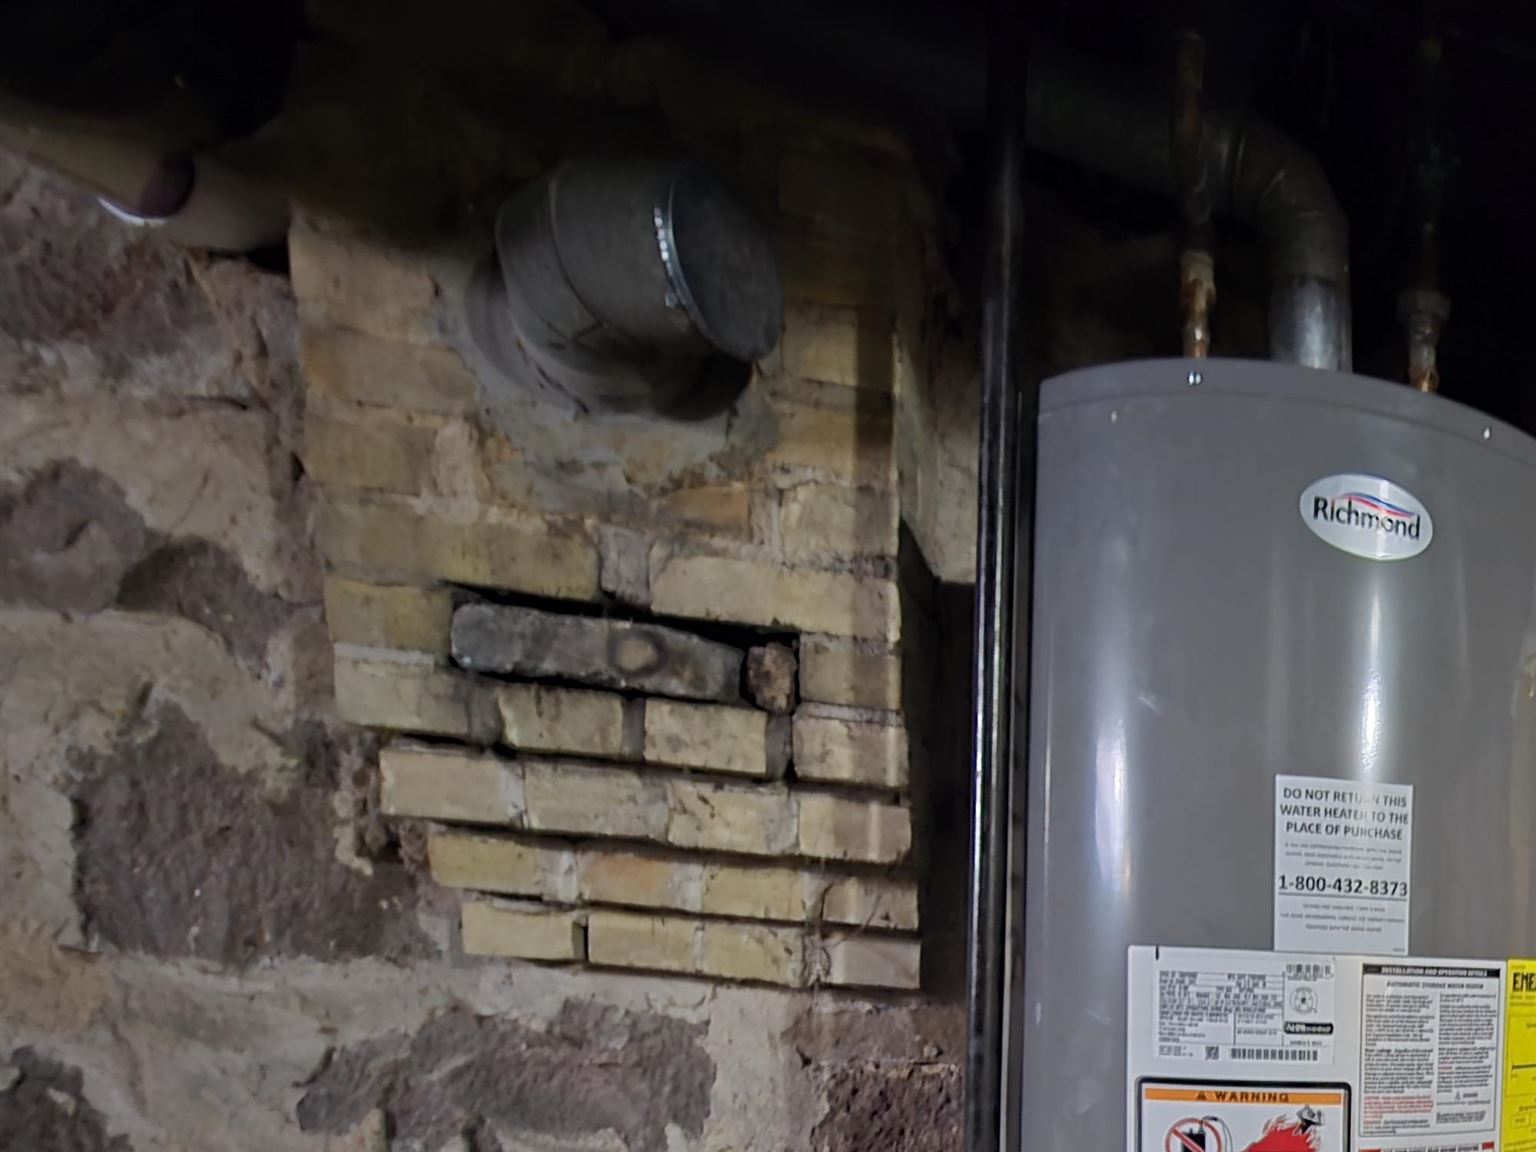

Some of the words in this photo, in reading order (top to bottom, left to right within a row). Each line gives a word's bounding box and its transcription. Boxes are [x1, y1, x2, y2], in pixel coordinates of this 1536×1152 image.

[1313, 496, 1421, 540] Richmond
[1283, 787, 1302, 799] DO
[1305, 789, 1331, 802] NOT
[1333, 791, 1380, 805] RETUN
[1382, 795, 1408, 808] THIS
[1280, 804, 1321, 818] WATER
[1370, 811, 1386, 823] TO
[1389, 812, 1409, 825] THE
[1286, 821, 1322, 834] PLACE
[1325, 823, 1342, 835] OF
[1344, 825, 1403, 840] PURCHASE
[1278, 874, 1409, 897] 1-800-432-8373
[1215, 1091, 1290, 1104] WARNING
